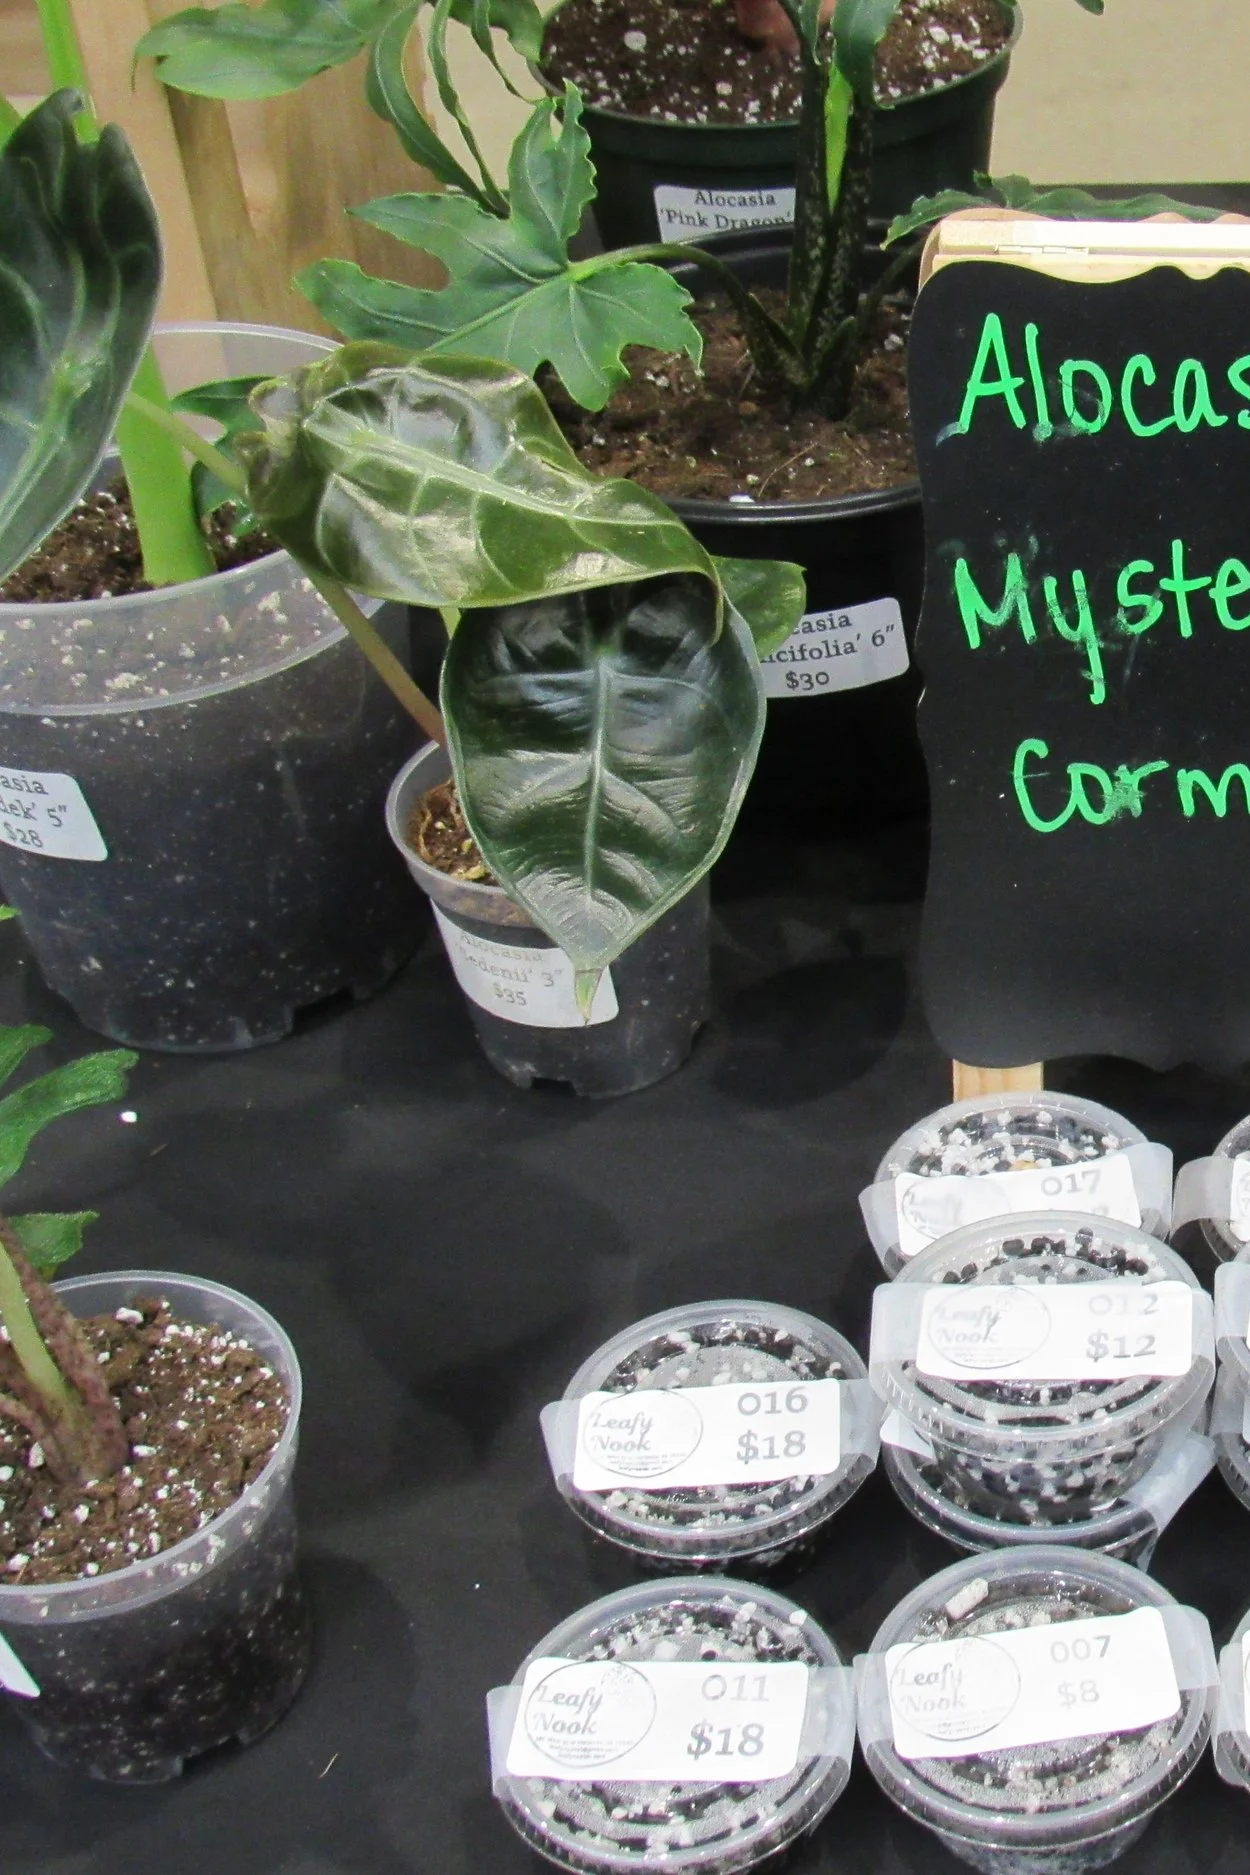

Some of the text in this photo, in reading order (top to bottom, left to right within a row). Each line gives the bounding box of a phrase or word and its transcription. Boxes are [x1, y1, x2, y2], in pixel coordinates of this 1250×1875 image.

[694, 189, 777, 207] Alocasia
[871, 623, 895, 647] 6"
[785, 669, 830, 692] $30
[1040, 1168, 1100, 1196] 017
[934, 1302, 1002, 1330] Leafy
[1088, 1294, 1160, 1316] 012
[936, 1324, 999, 1345] Nook
[1085, 1329, 1157, 1362] $12
[737, 1387, 808, 1416] 016
[590, 1411, 654, 1435] Leafy
[591, 1432, 652, 1453] Nook
[736, 1429, 806, 1465] $18
[1050, 1634, 1112, 1664] 007
[702, 1674, 770, 1702] 011
[898, 1662, 963, 1692] Leafy
[535, 1684, 604, 1715] Leafy
[900, 1692, 968, 1714] Nook
[1057, 1679, 1100, 1710] $8
[533, 1711, 599, 1736] Nook
[687, 1718, 765, 1761] $18
